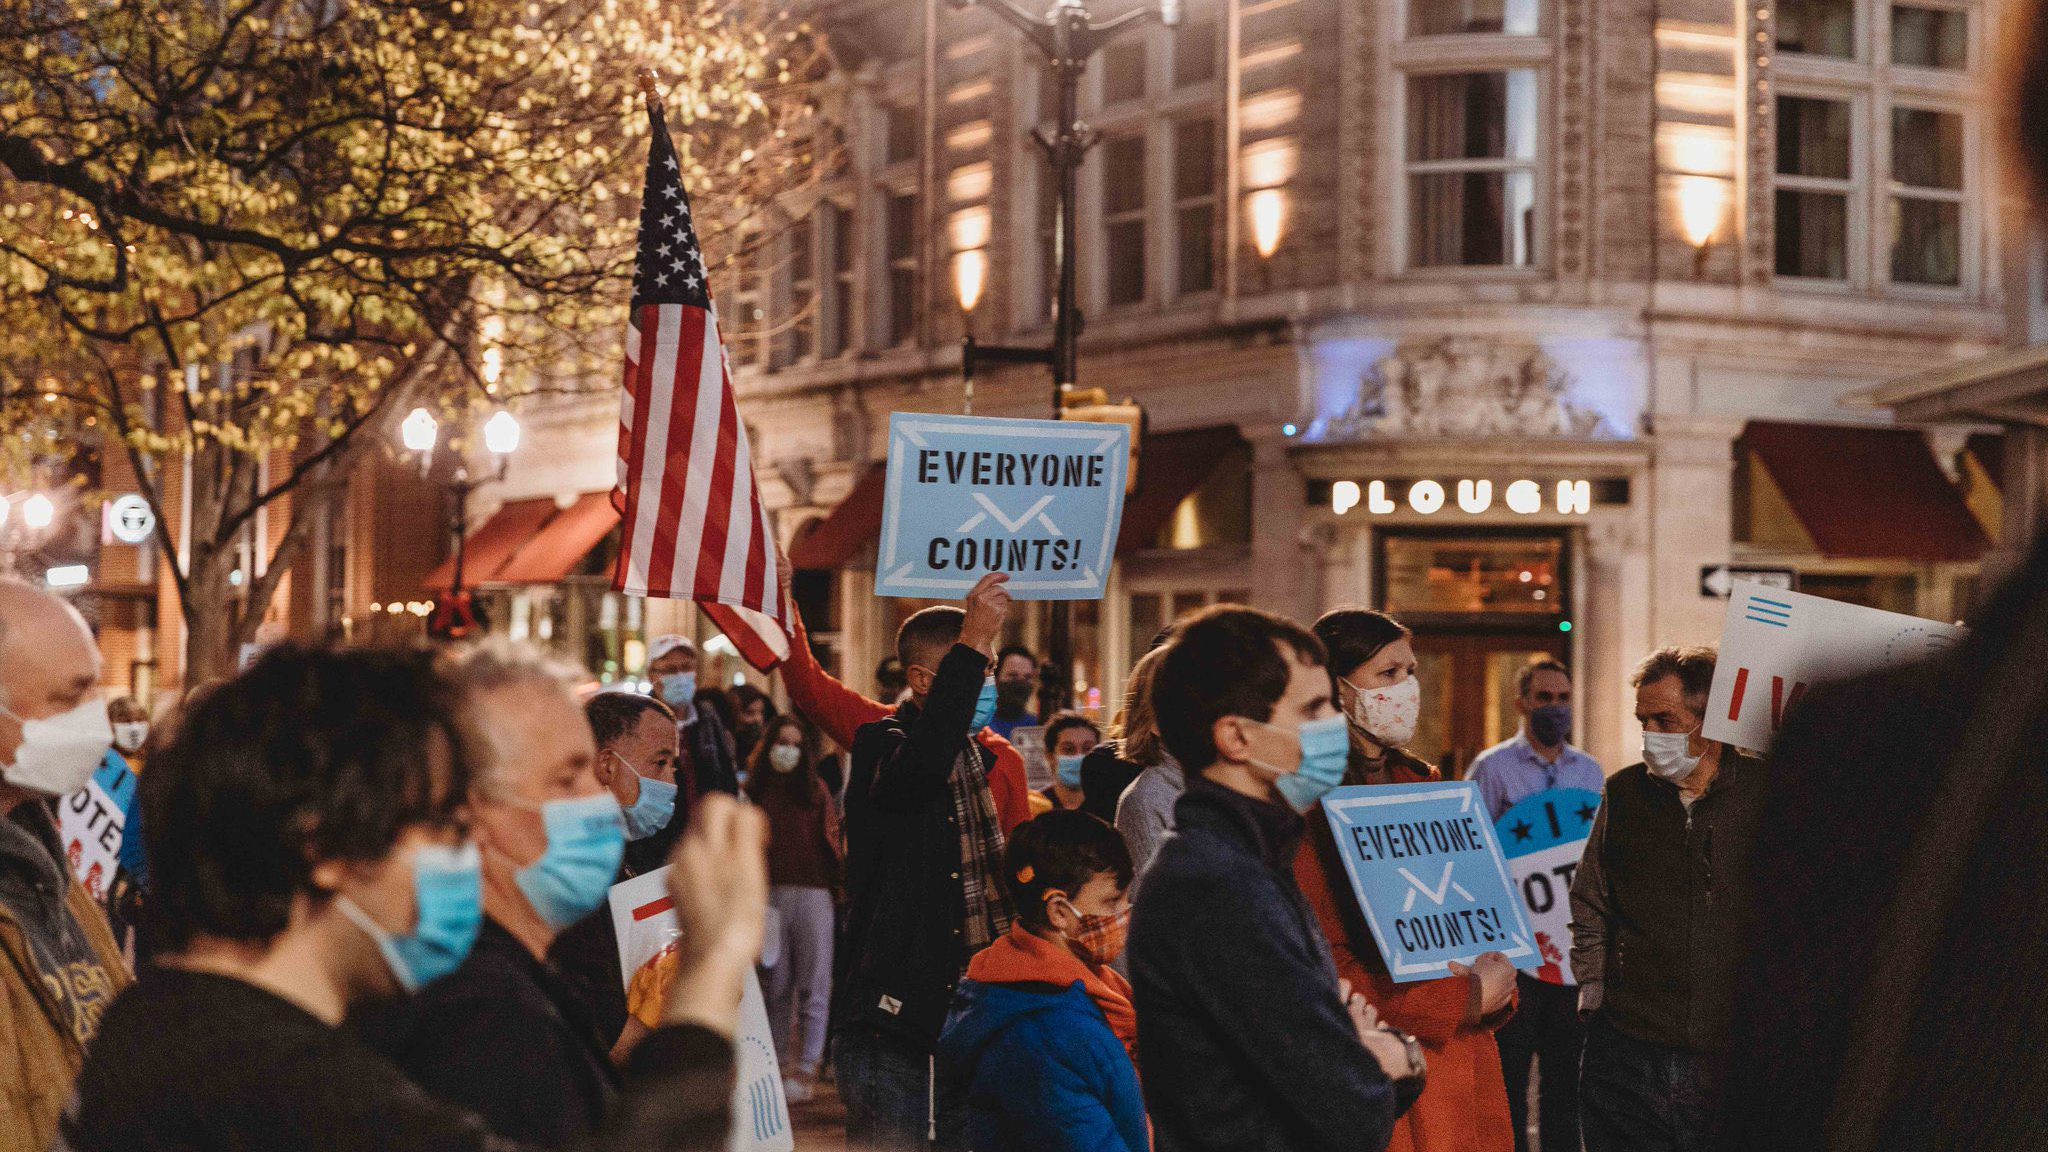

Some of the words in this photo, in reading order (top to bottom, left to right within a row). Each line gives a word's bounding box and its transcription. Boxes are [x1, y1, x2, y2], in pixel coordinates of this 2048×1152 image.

[918, 449, 1104, 488] EVERYONE
[1332, 479, 1591, 515] PLOUGH
[927, 537, 1082, 572] COUNTS!
[69, 787, 123, 853] OTE
[1351, 816, 1483, 861] EVERYONE
[1544, 801, 1562, 838] I
[1514, 862, 1579, 914] OT
[1394, 906, 1506, 953] COUNTS!
